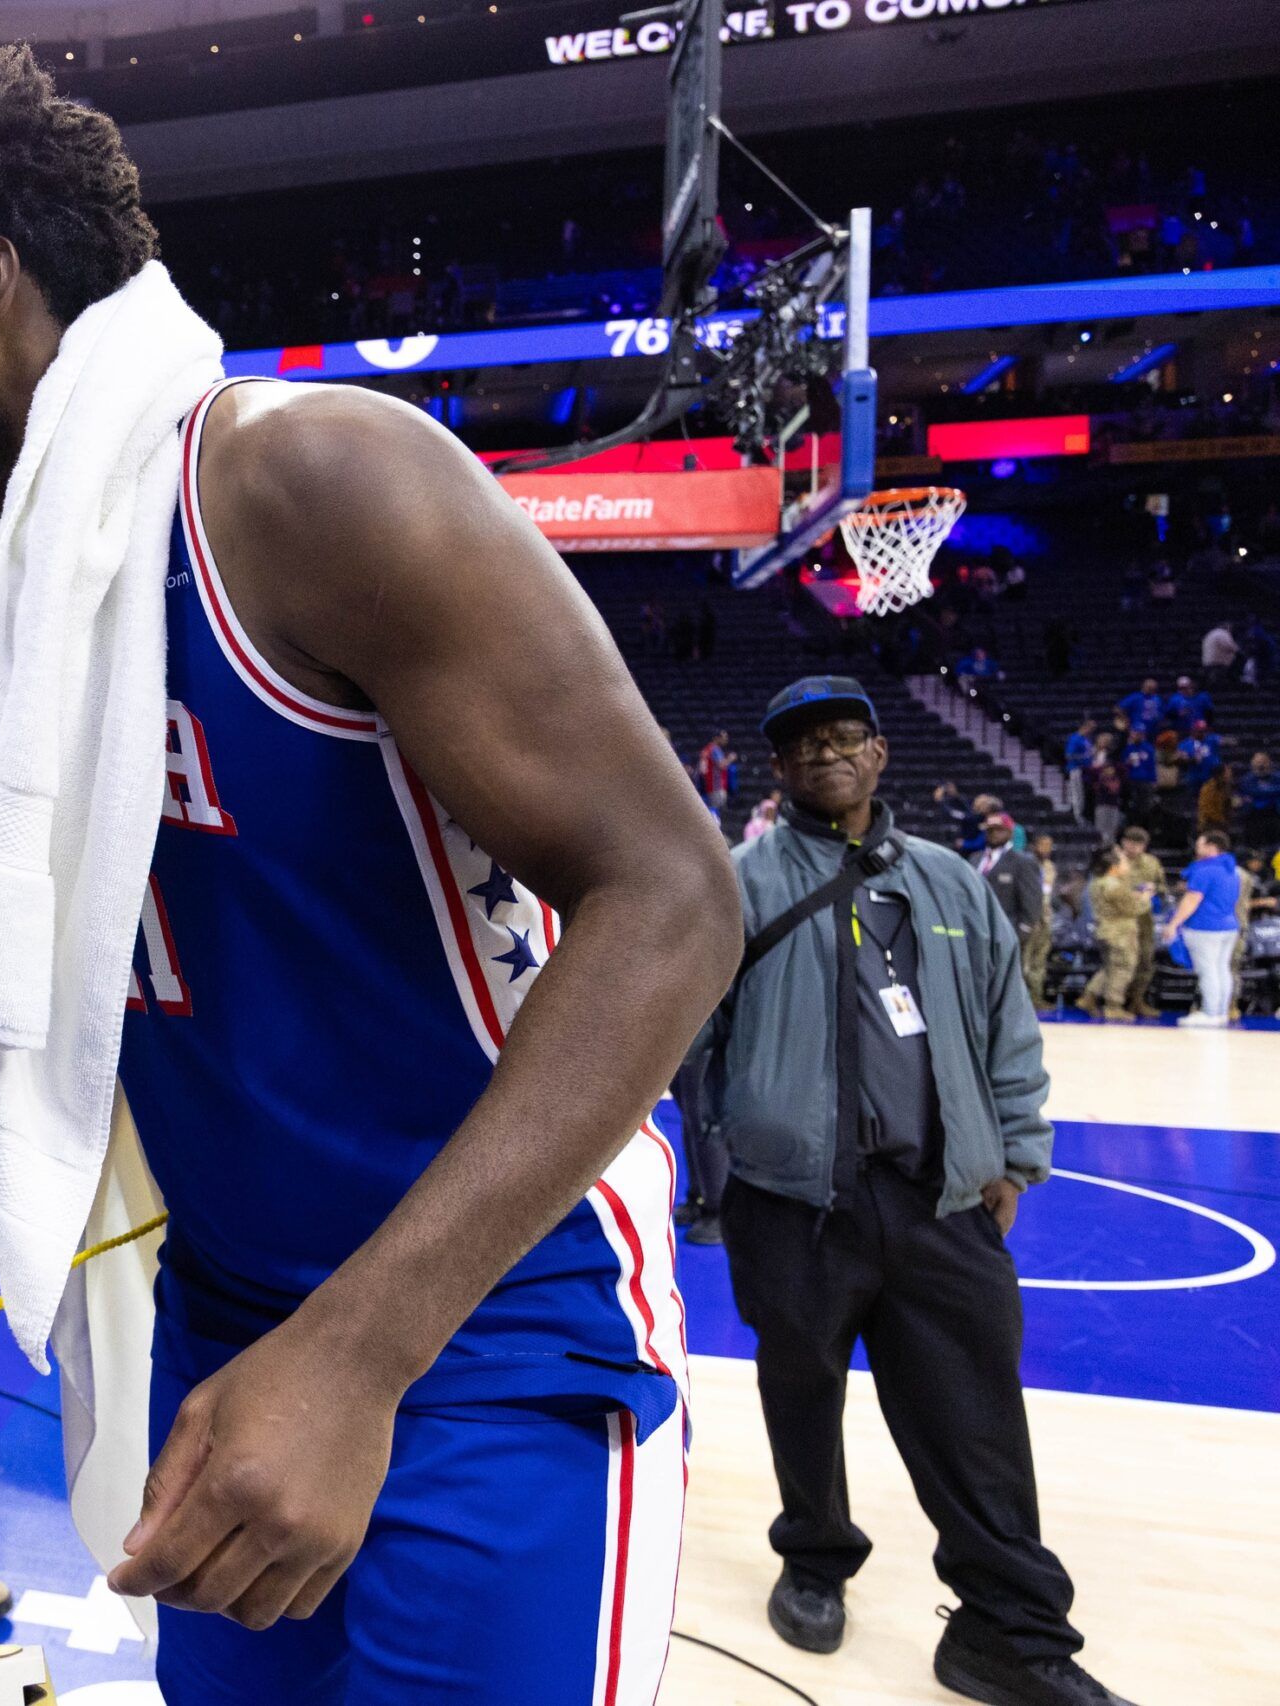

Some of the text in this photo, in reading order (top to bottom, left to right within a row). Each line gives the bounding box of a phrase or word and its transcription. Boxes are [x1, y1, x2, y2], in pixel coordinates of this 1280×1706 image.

[545, 8, 769, 64] WELCE
[785, 1, 851, 33] TO
[166, 571, 189, 588] om
[161, 699, 238, 836] A
[125, 872, 193, 1017] 1
